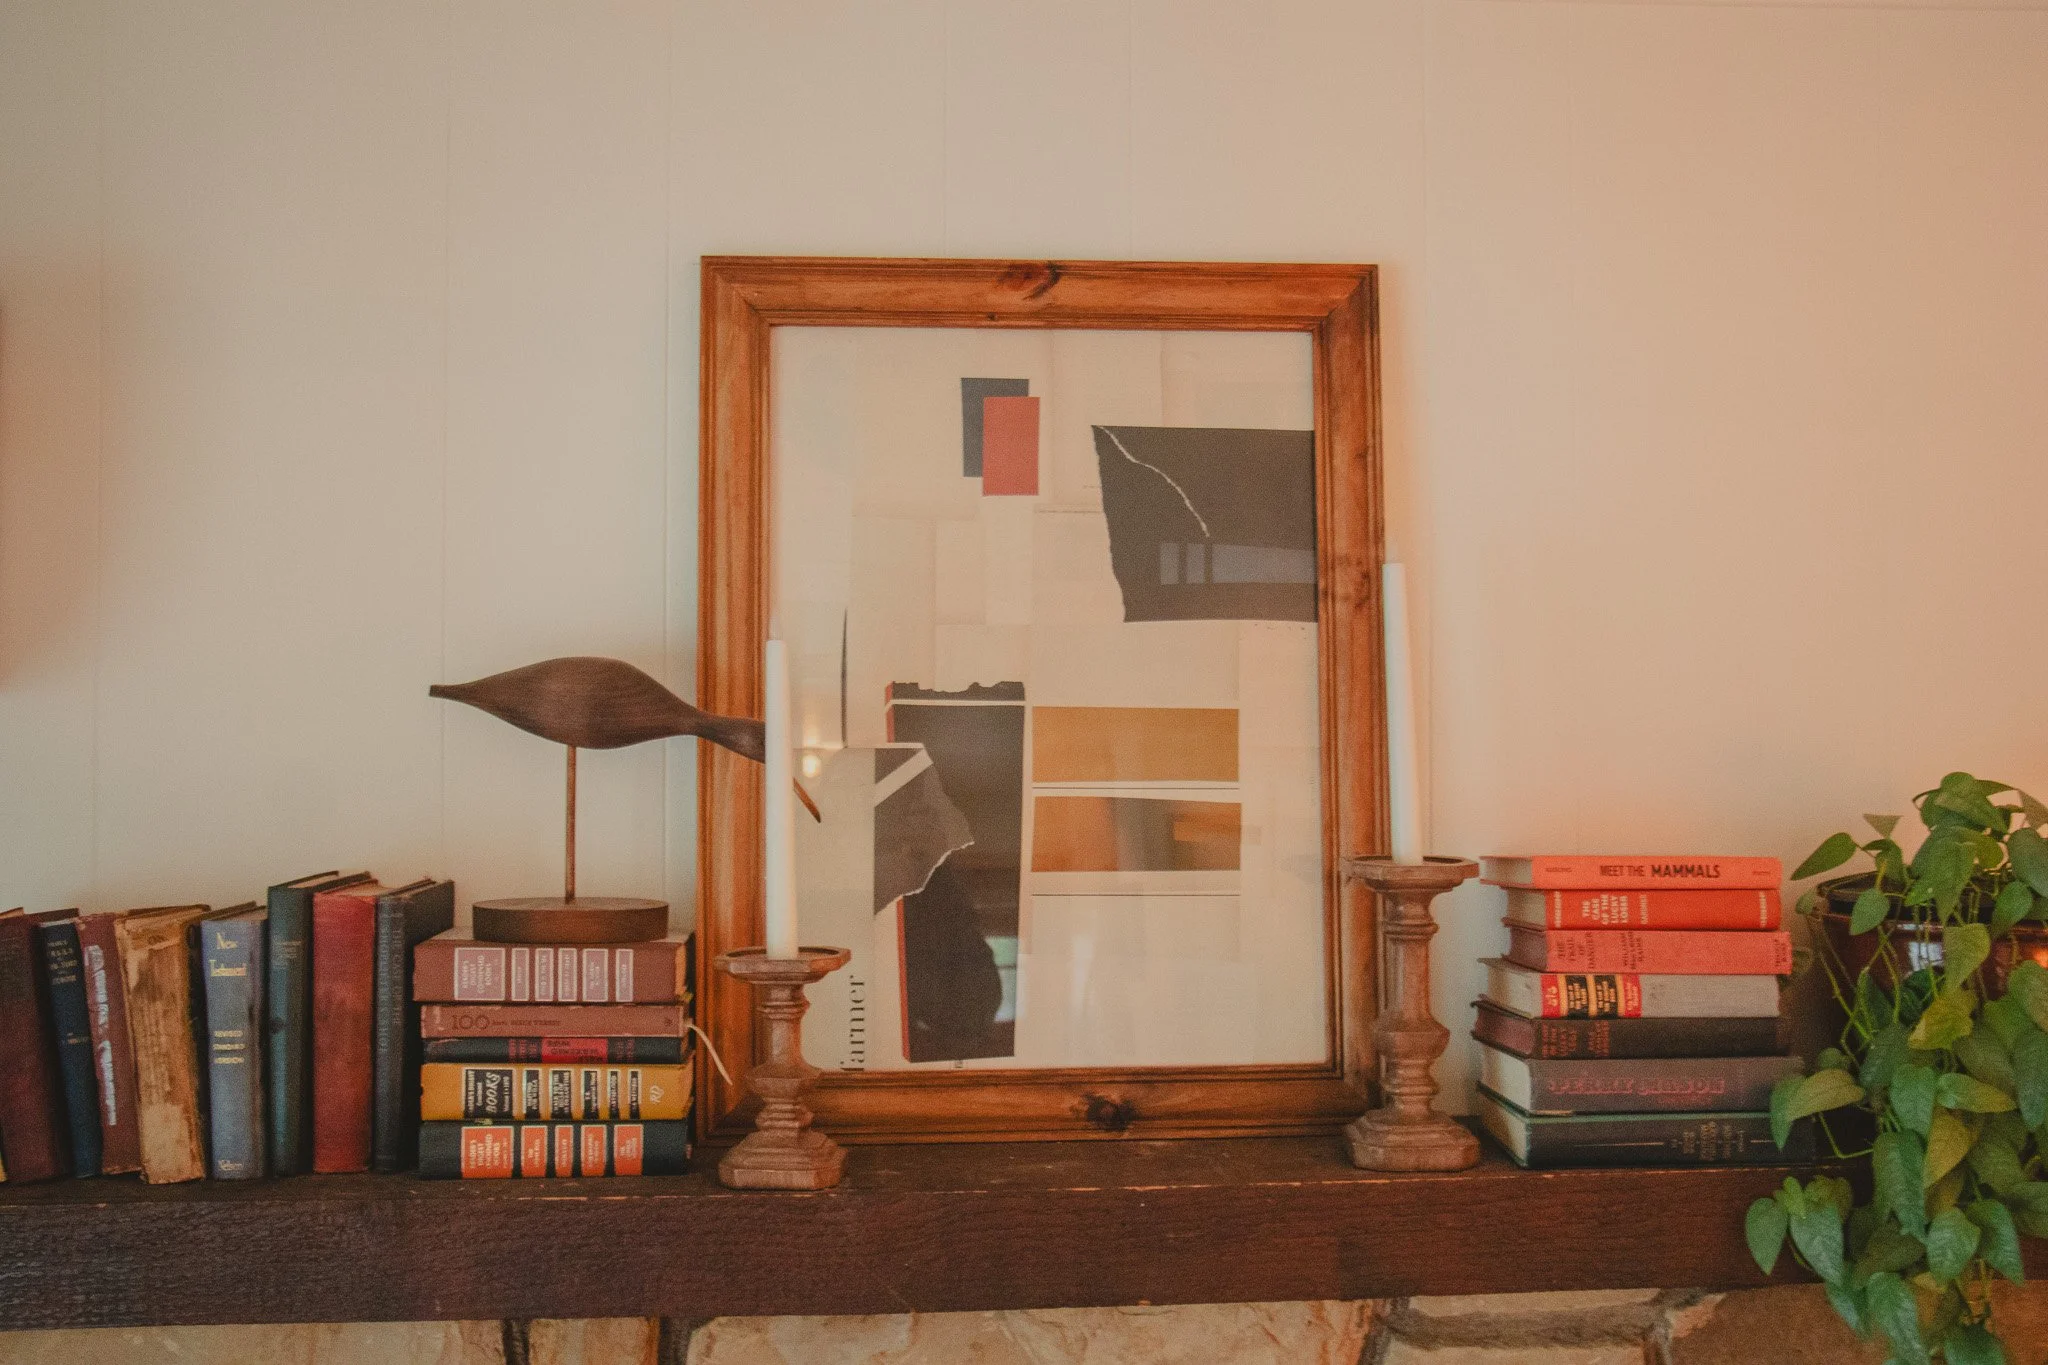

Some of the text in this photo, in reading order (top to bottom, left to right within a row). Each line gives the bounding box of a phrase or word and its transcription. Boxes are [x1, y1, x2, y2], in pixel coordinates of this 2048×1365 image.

[1599, 864, 1721, 878] MEET THE MAMMALS
[1581, 900, 1591, 918] THE
[1591, 898, 1600, 921] CASE
[1600, 893, 1610, 926] OF THE
[1610, 895, 1619, 924] LUCKY
[1619, 895, 1628, 924] LOSER
[216, 931, 238, 950] New
[1556, 941, 1565, 959] THE
[1566, 937, 1576, 962] TRAIL
[1585, 931, 1595, 970] DANGER
[452, 1014, 490, 1030] 100
[485, 1071, 501, 1114] BOOKS
